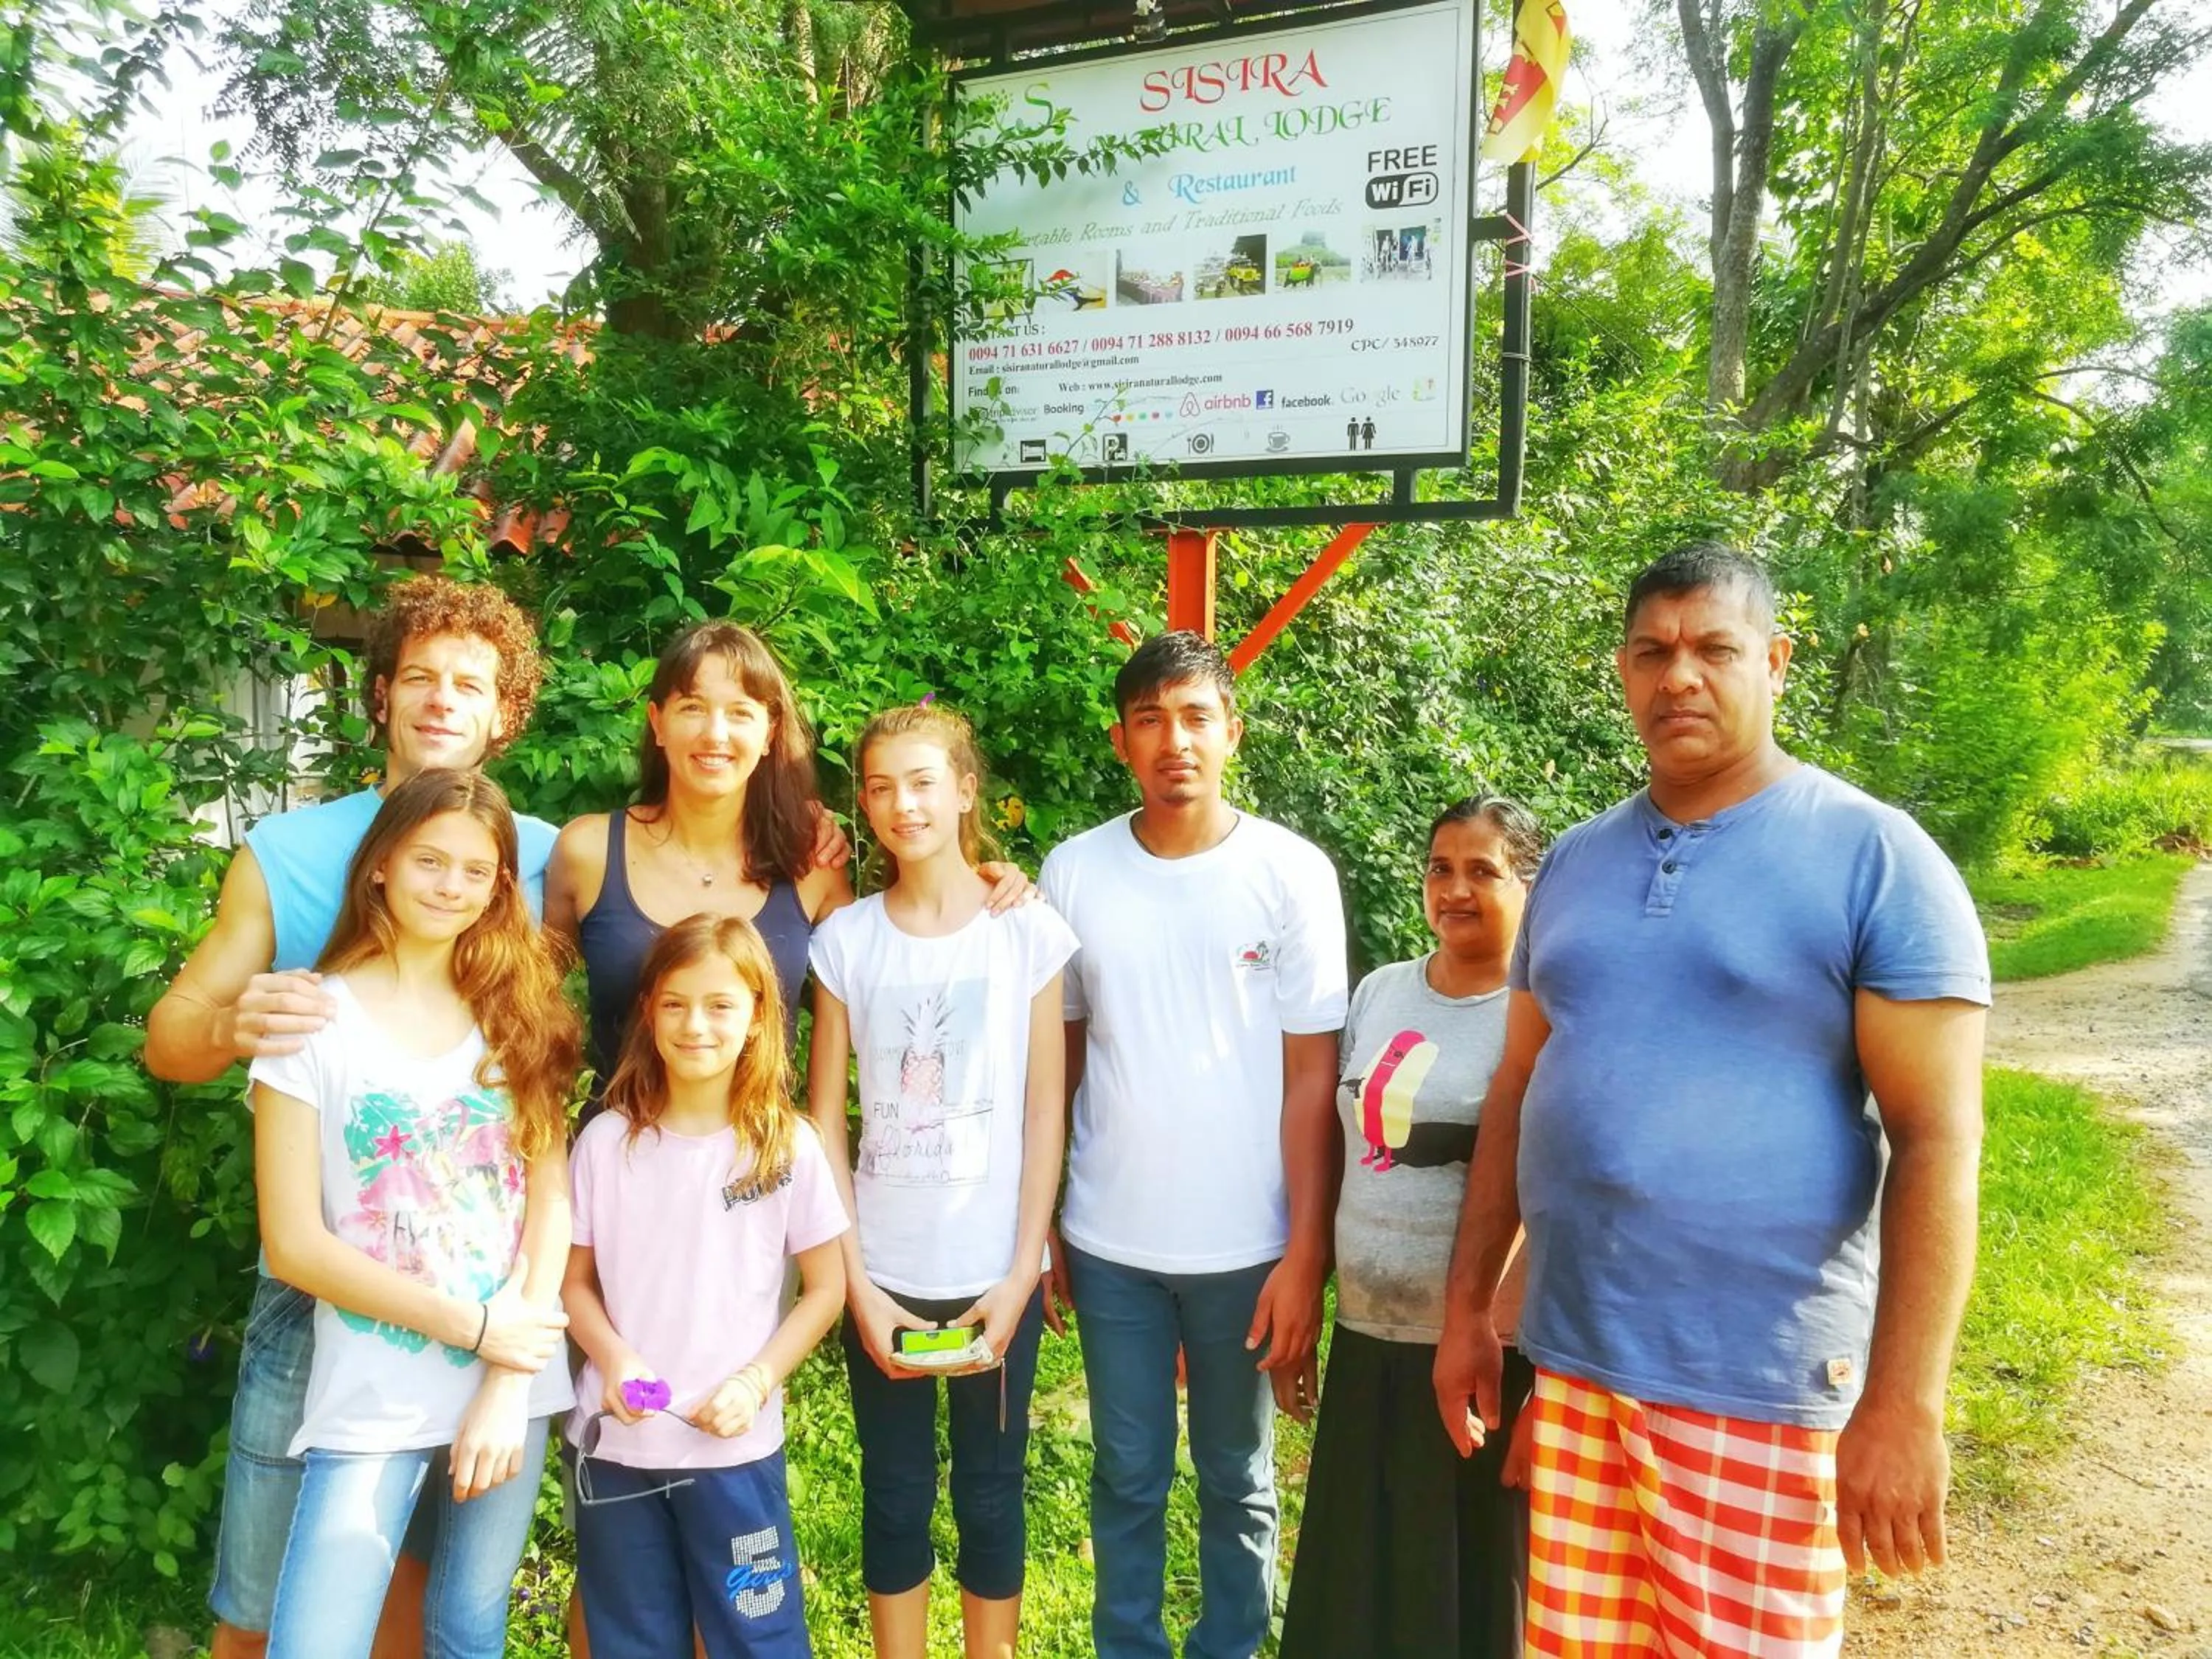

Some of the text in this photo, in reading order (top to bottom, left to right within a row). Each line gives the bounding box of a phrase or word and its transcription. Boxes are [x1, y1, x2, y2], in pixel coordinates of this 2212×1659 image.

[1140, 47, 1329, 111] SISIRA
[1264, 97, 1391, 141] LODGE
[1368, 145, 1438, 172] FREE
[1122, 165, 1297, 206] & Restaurant
[1079, 221, 1133, 242] Rooms
[1141, 215, 1177, 234] and
[1183, 204, 1285, 229] Traditional
[968, 347, 998, 361] 0094
[1002, 344, 1015, 358] 71
[1048, 340, 1079, 355] 6627
[1091, 335, 1123, 352] 0094
[1128, 334, 1143, 349] 71
[1149, 332, 1173, 347] 288
[1178, 330, 1211, 345] 8132
[1225, 326, 1259, 341] 0094
[1265, 324, 1281, 339] 66
[1286, 321, 1312, 338] 568
[1318, 319, 1354, 335] 7919
[969, 364, 995, 375] Email
[1058, 381, 1079, 392] Web
[1044, 404, 1084, 415] Booking
[1204, 394, 1251, 411] airbnb
[1281, 394, 1331, 408] facebook
[874, 1102, 899, 1119] FUN
[731, 1526, 785, 1618] 5
